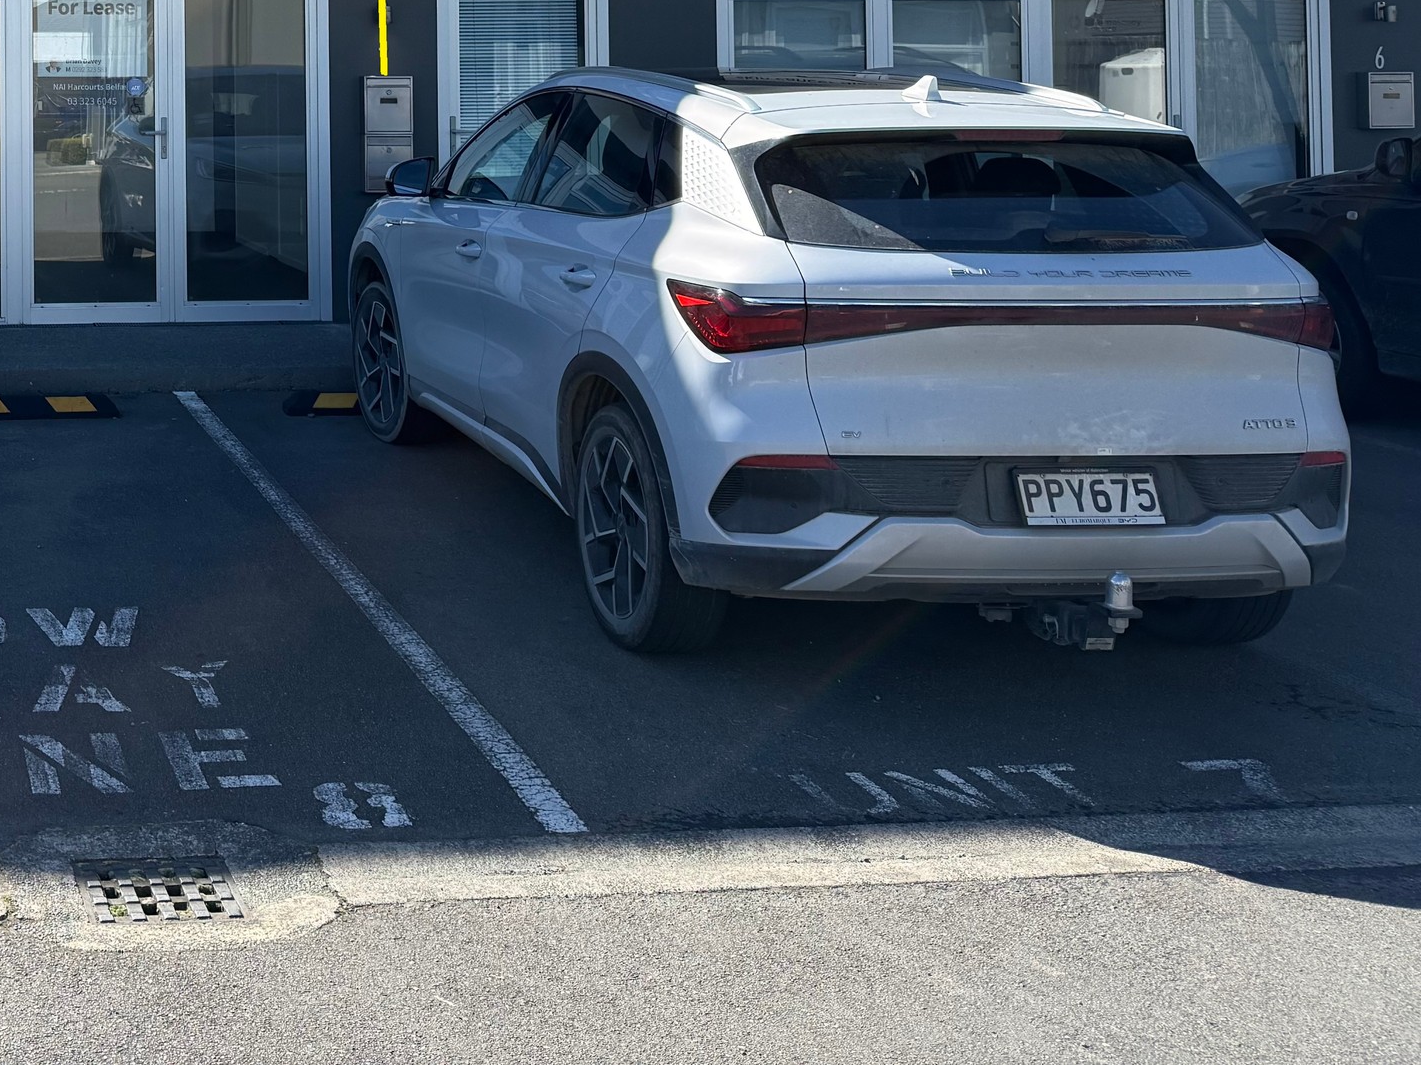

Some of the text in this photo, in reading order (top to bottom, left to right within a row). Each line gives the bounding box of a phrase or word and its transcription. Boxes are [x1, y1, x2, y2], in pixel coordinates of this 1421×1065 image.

[48, 0, 136, 16] For Lease
[1375, 46, 1385, 69] 6
[68, 97, 117, 106] 03 323 6045
[949, 267, 1021, 278] BUILD
[1027, 270, 1093, 278] YOUR
[1242, 418, 1284, 430] ATTO
[841, 430, 862, 438] EV
[1021, 478, 1157, 513] PPY675
[787, 763, 1095, 814] UNIT
[313, 781, 415, 830] 8
